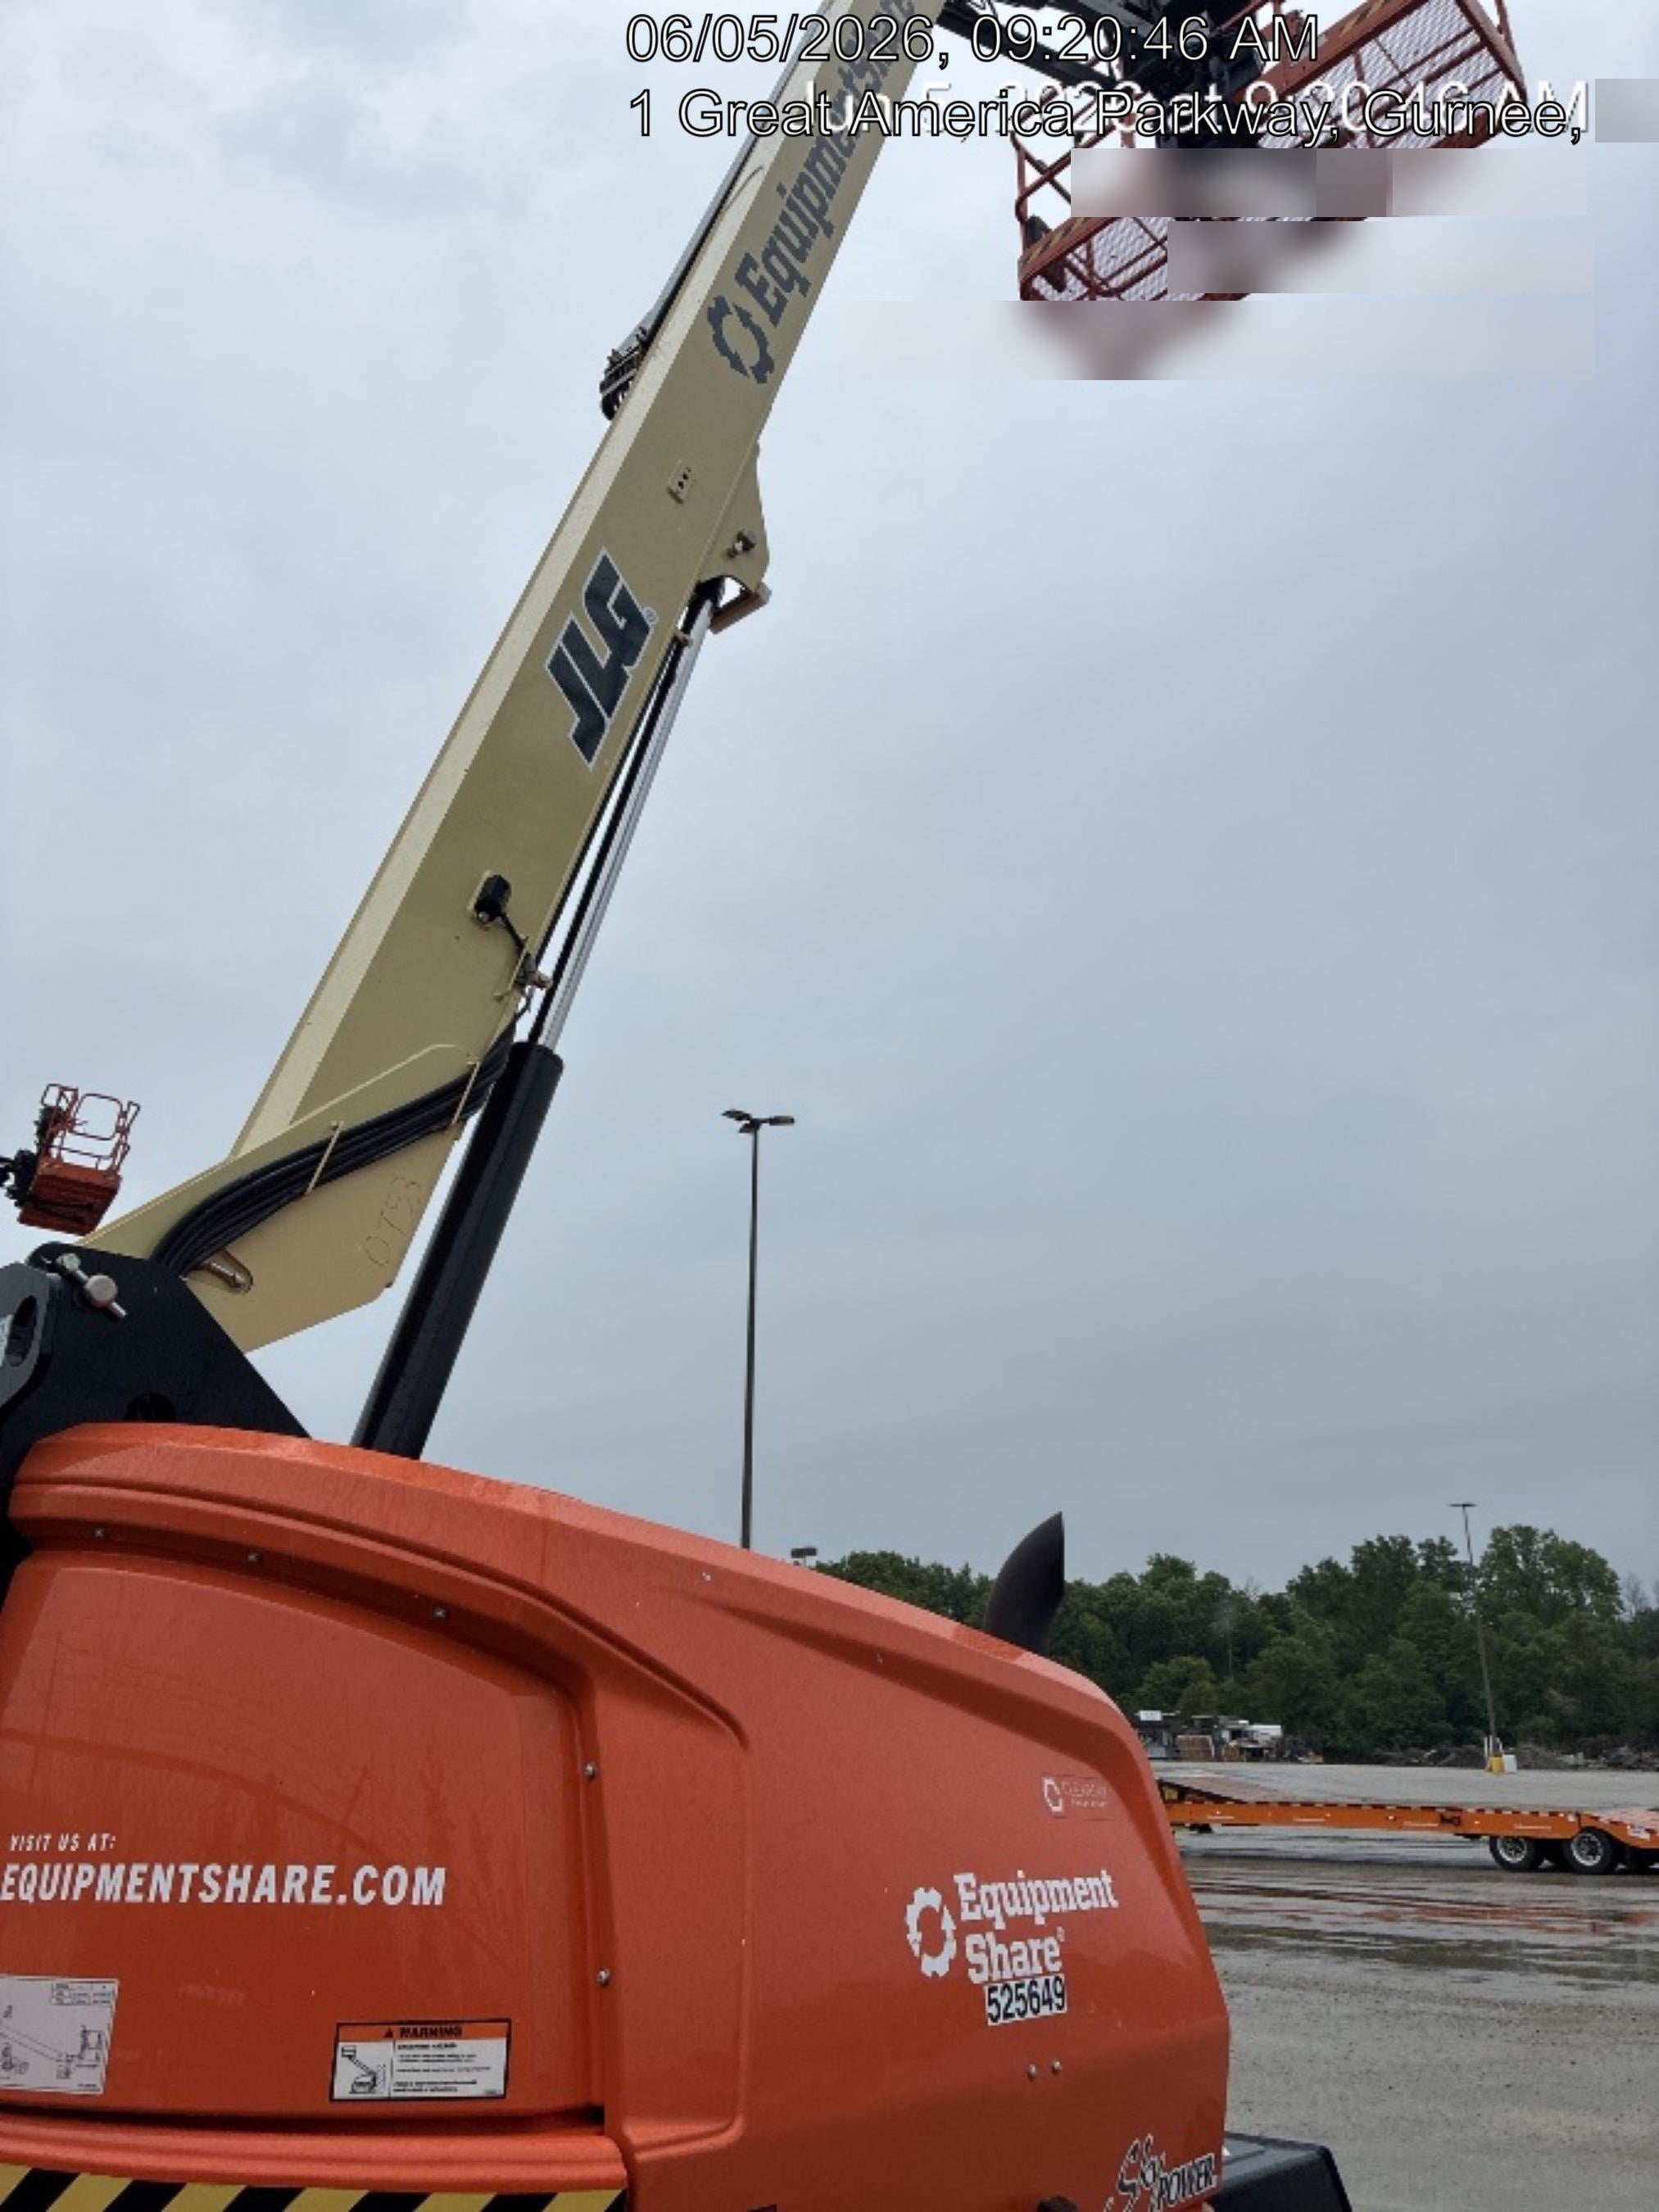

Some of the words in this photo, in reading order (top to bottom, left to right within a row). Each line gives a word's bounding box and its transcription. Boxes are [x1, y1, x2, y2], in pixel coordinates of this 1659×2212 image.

[545, 548, 655, 771] JLG
[9, 1834, 52, 1852] VISIT
[58, 1833, 79, 1852] US
[88, 1833, 116, 1852] AT:
[0, 1861, 446, 1906] EQUIPMENTSHARE.COM
[954, 1870, 1118, 1929] Equipment
[987, 1975, 1064, 2023] 525649
